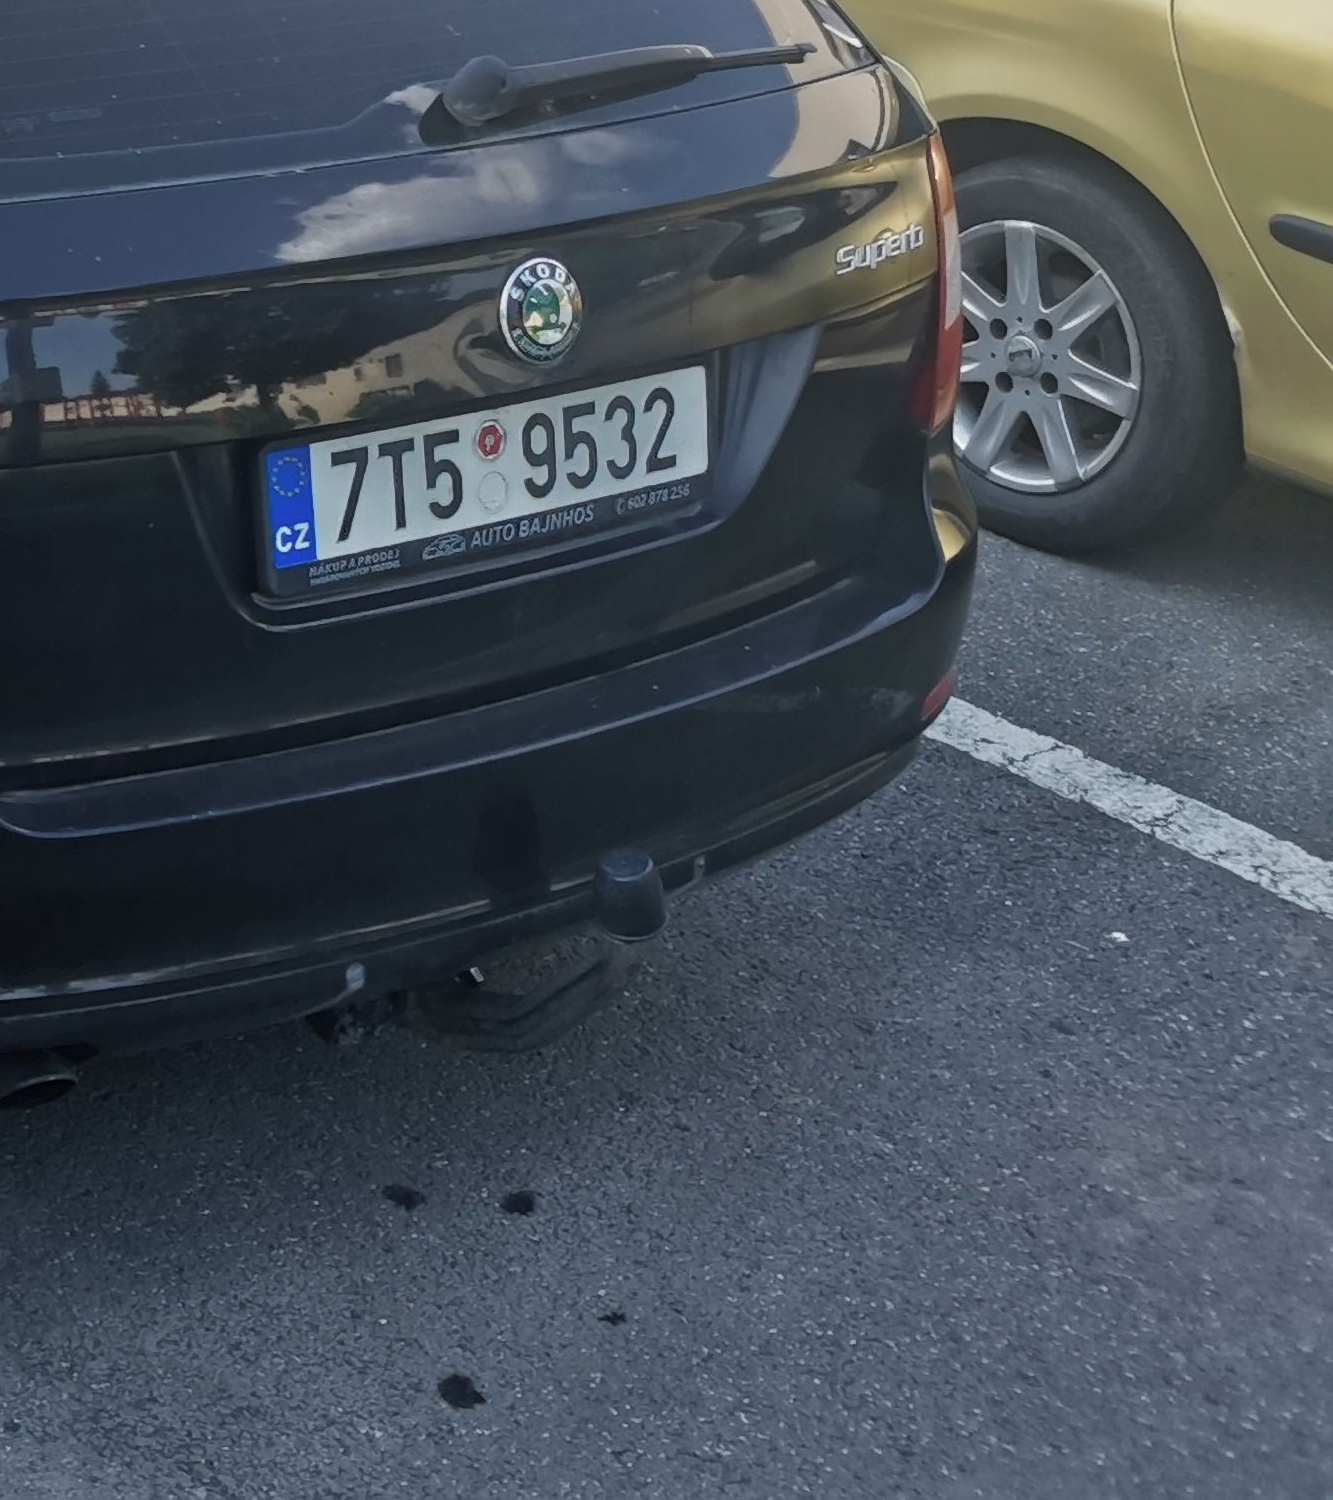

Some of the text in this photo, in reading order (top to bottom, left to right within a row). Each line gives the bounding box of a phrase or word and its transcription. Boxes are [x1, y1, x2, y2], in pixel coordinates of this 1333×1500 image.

[836, 224, 924, 275] Superb
[329, 386, 678, 545] 7T5 9532
[275, 522, 310, 553] CZ
[470, 523, 515, 549] AUTO
